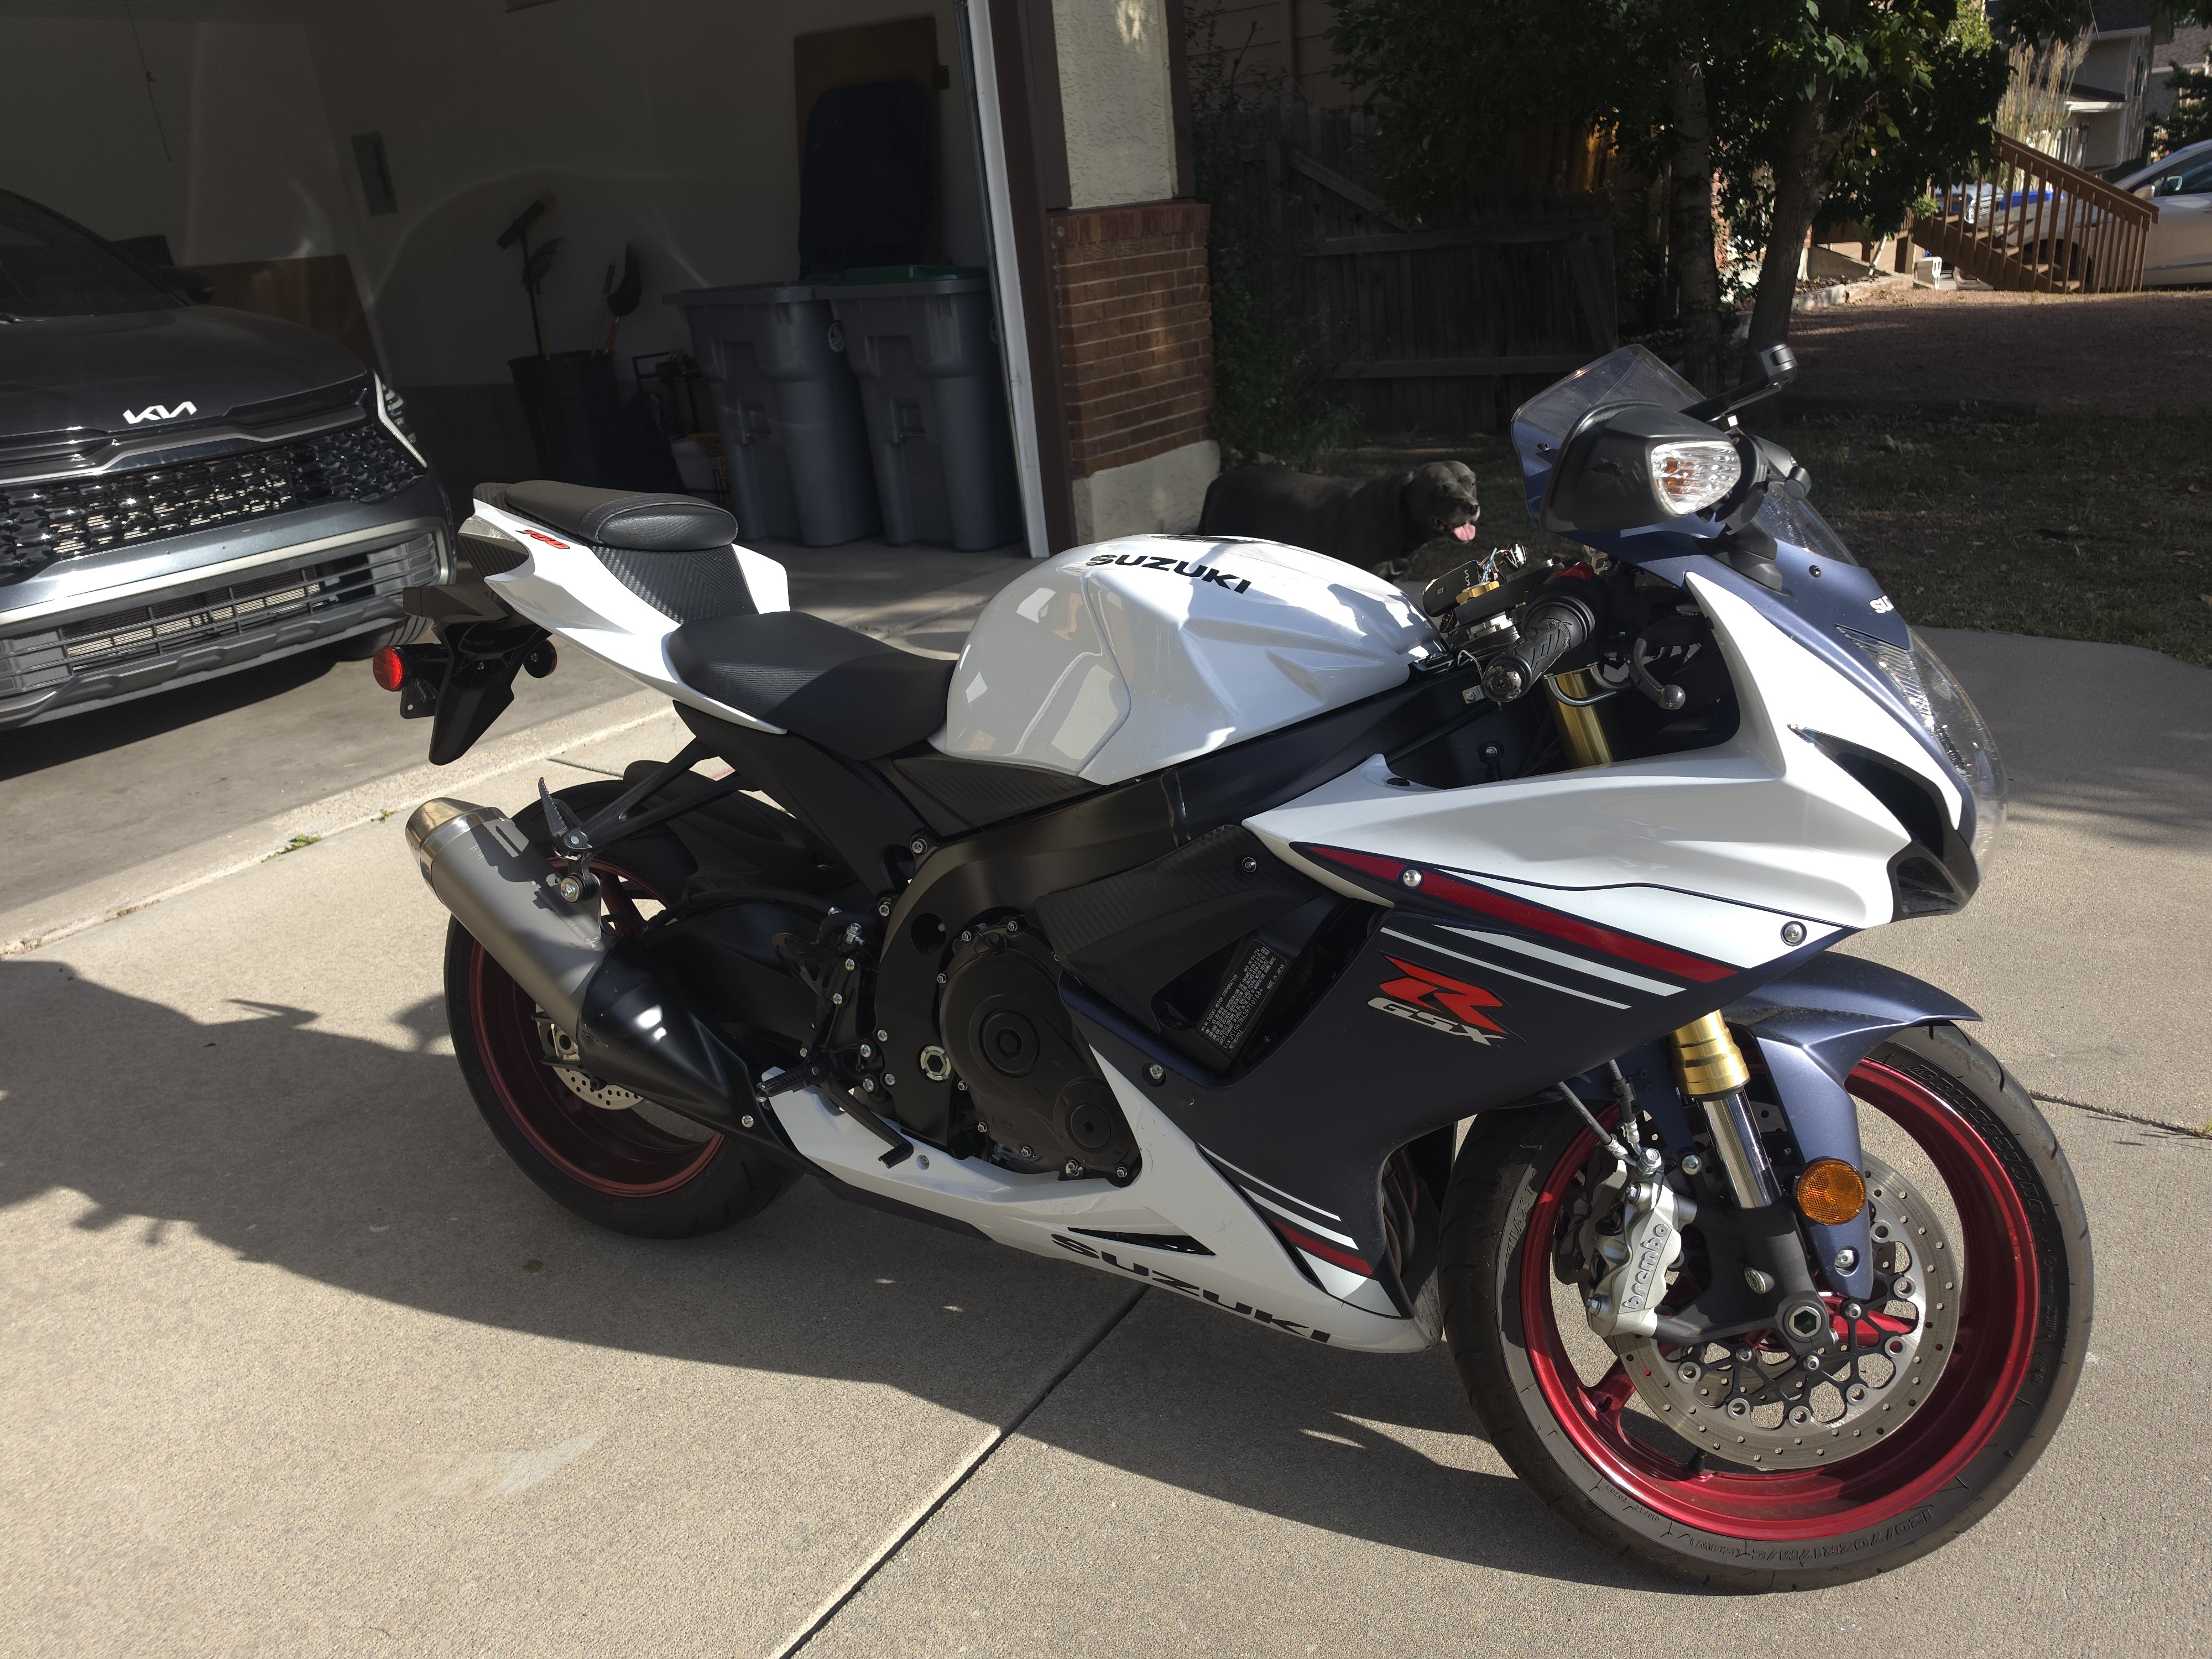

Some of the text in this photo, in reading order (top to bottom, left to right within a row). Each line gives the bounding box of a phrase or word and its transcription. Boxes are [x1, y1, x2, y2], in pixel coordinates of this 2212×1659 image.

[1086, 555, 1251, 594] SUZUKI
[1207, 1009, 1215, 1021] SUZUKI
[1215, 997, 1223, 1008] MOTOR
[1222, 974, 1238, 997] CORPORATION
[1276, 963, 1285, 975] JAPAN
[1379, 956, 1508, 1034] R
[1908, 1064, 2048, 1215] BRIDGESTONE
[1051, 1234, 1331, 1343] SUZUKI
[1621, 1223, 1669, 1310] brembo
